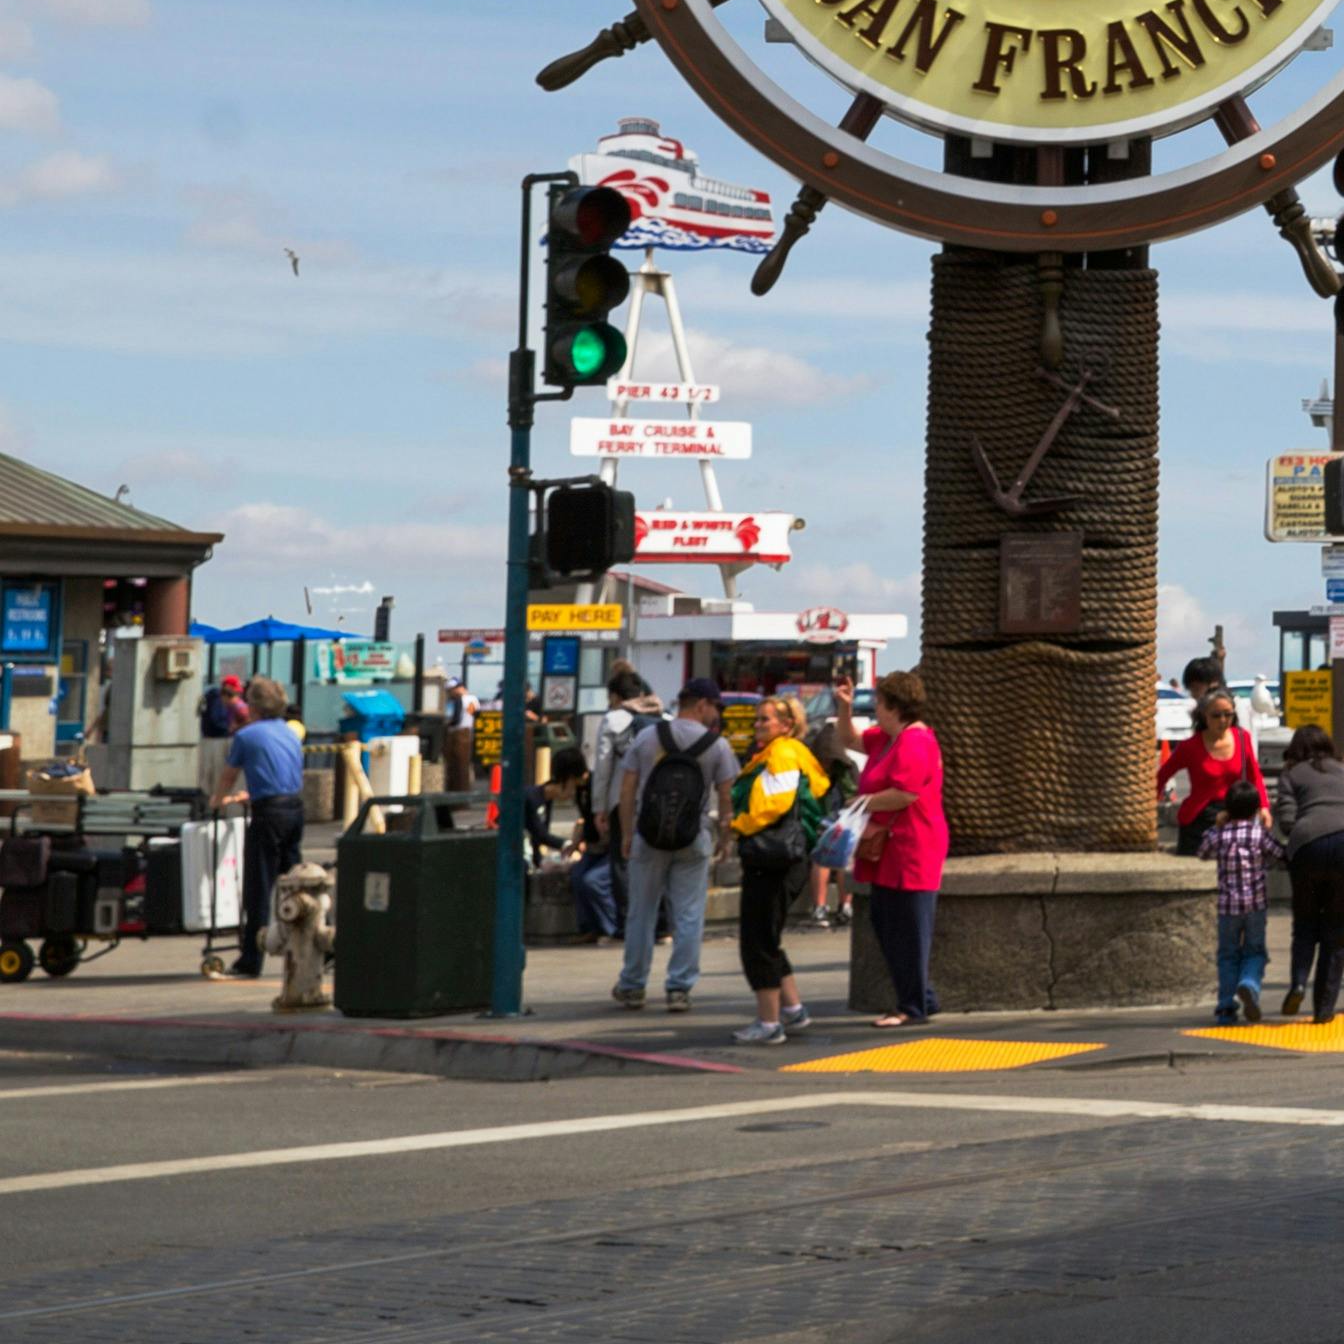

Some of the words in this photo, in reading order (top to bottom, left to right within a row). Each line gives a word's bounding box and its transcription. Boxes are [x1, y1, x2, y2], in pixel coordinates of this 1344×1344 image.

[616, 385, 651, 397] PIER
[660, 386, 680, 398] 43
[609, 424, 634, 436] BAY
[643, 425, 697, 438] CRUISE
[598, 441, 645, 453] FERRY
[653, 442, 726, 456] TERMINAL
[530, 609, 562, 623] PAY
[569, 608, 617, 624] HERE
